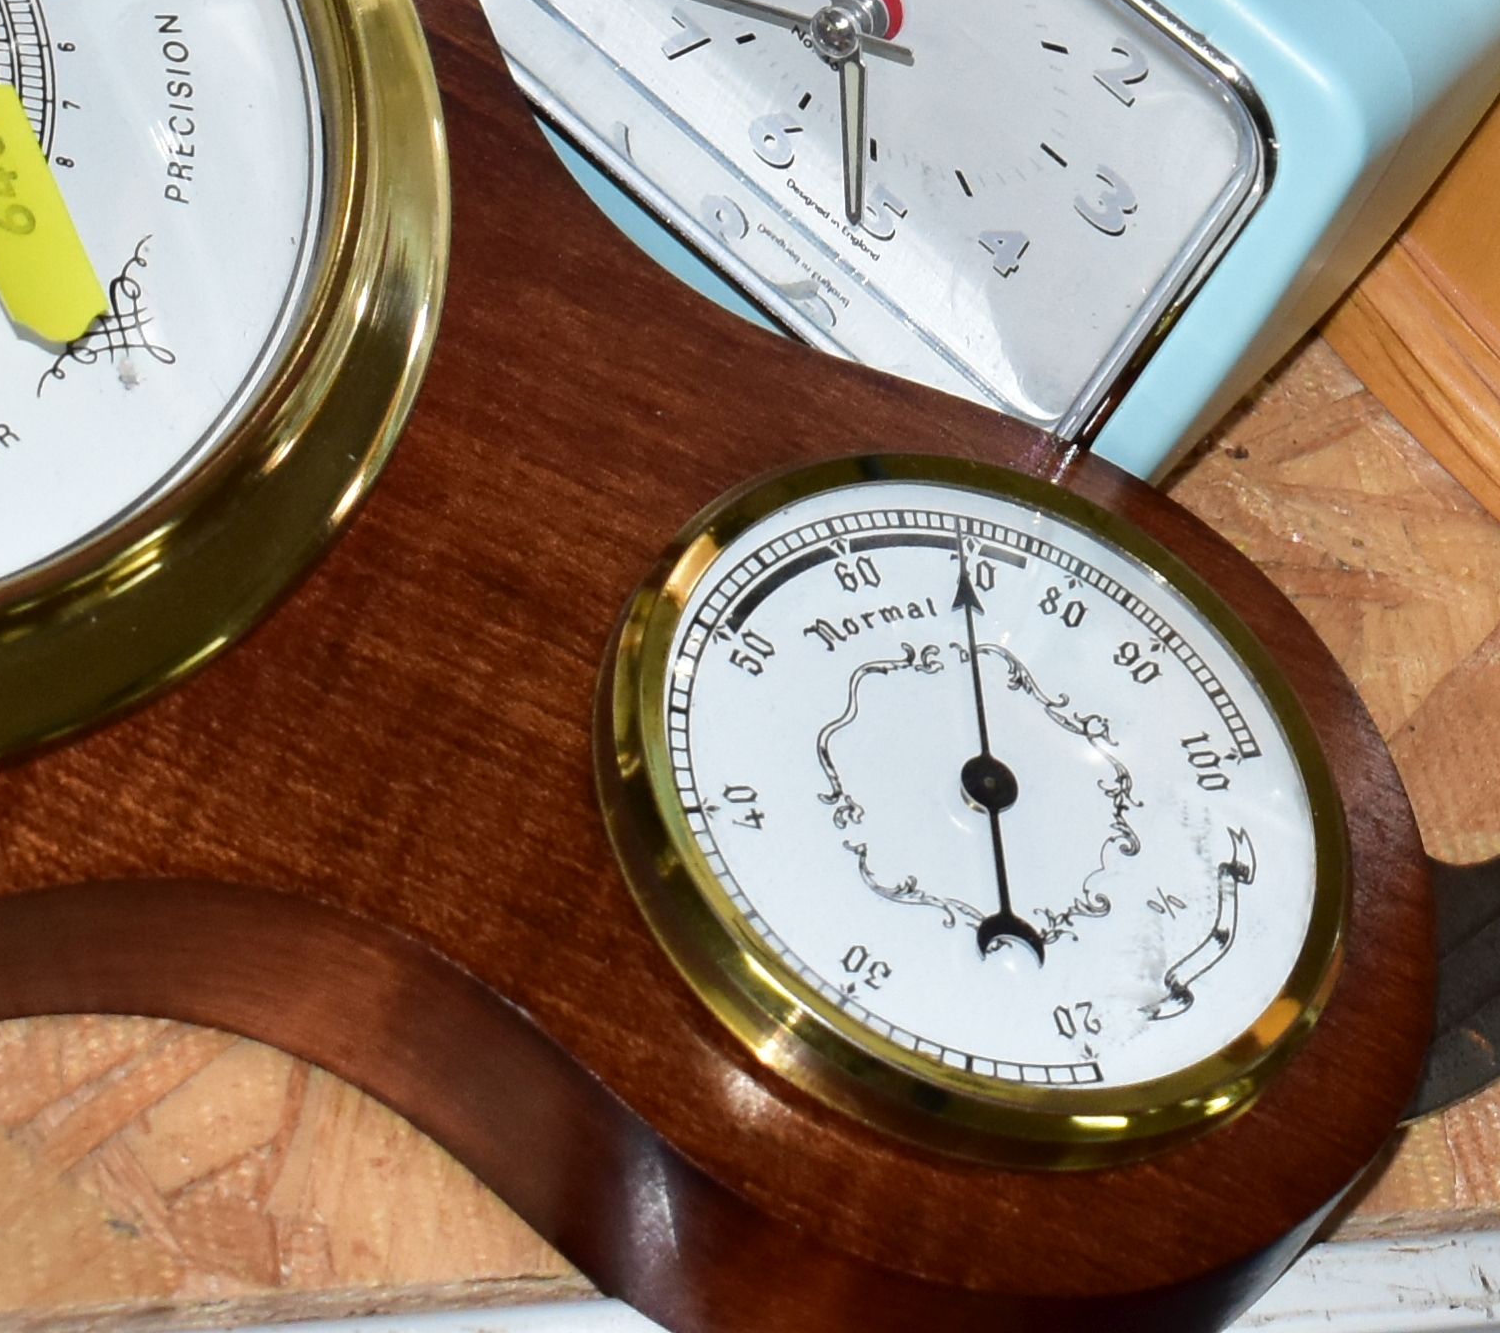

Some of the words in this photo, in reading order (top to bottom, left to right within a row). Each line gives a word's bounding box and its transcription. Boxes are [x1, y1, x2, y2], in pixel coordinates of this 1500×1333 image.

[1093, 36, 1149, 108] 2
[155, 14, 195, 204] PRECISION
[55, 156, 75, 169] 8
[787, 178, 830, 219] Designed
[841, 225, 881, 262] England
[857, 183, 908, 242] 5
[1073, 164, 1138, 237] 3
[978, 231, 1030, 278] 4
[834, 556, 881, 592] 60
[803, 598, 938, 652] Normal
[1039, 587, 1088, 630] 80
[729, 630, 777, 678] 50
[1112, 641, 1163, 687] 90
[1181, 731, 1228, 794] 100
[723, 784, 765, 832] 40
[842, 945, 892, 990] 30
[1053, 1000, 1102, 1040] 20
